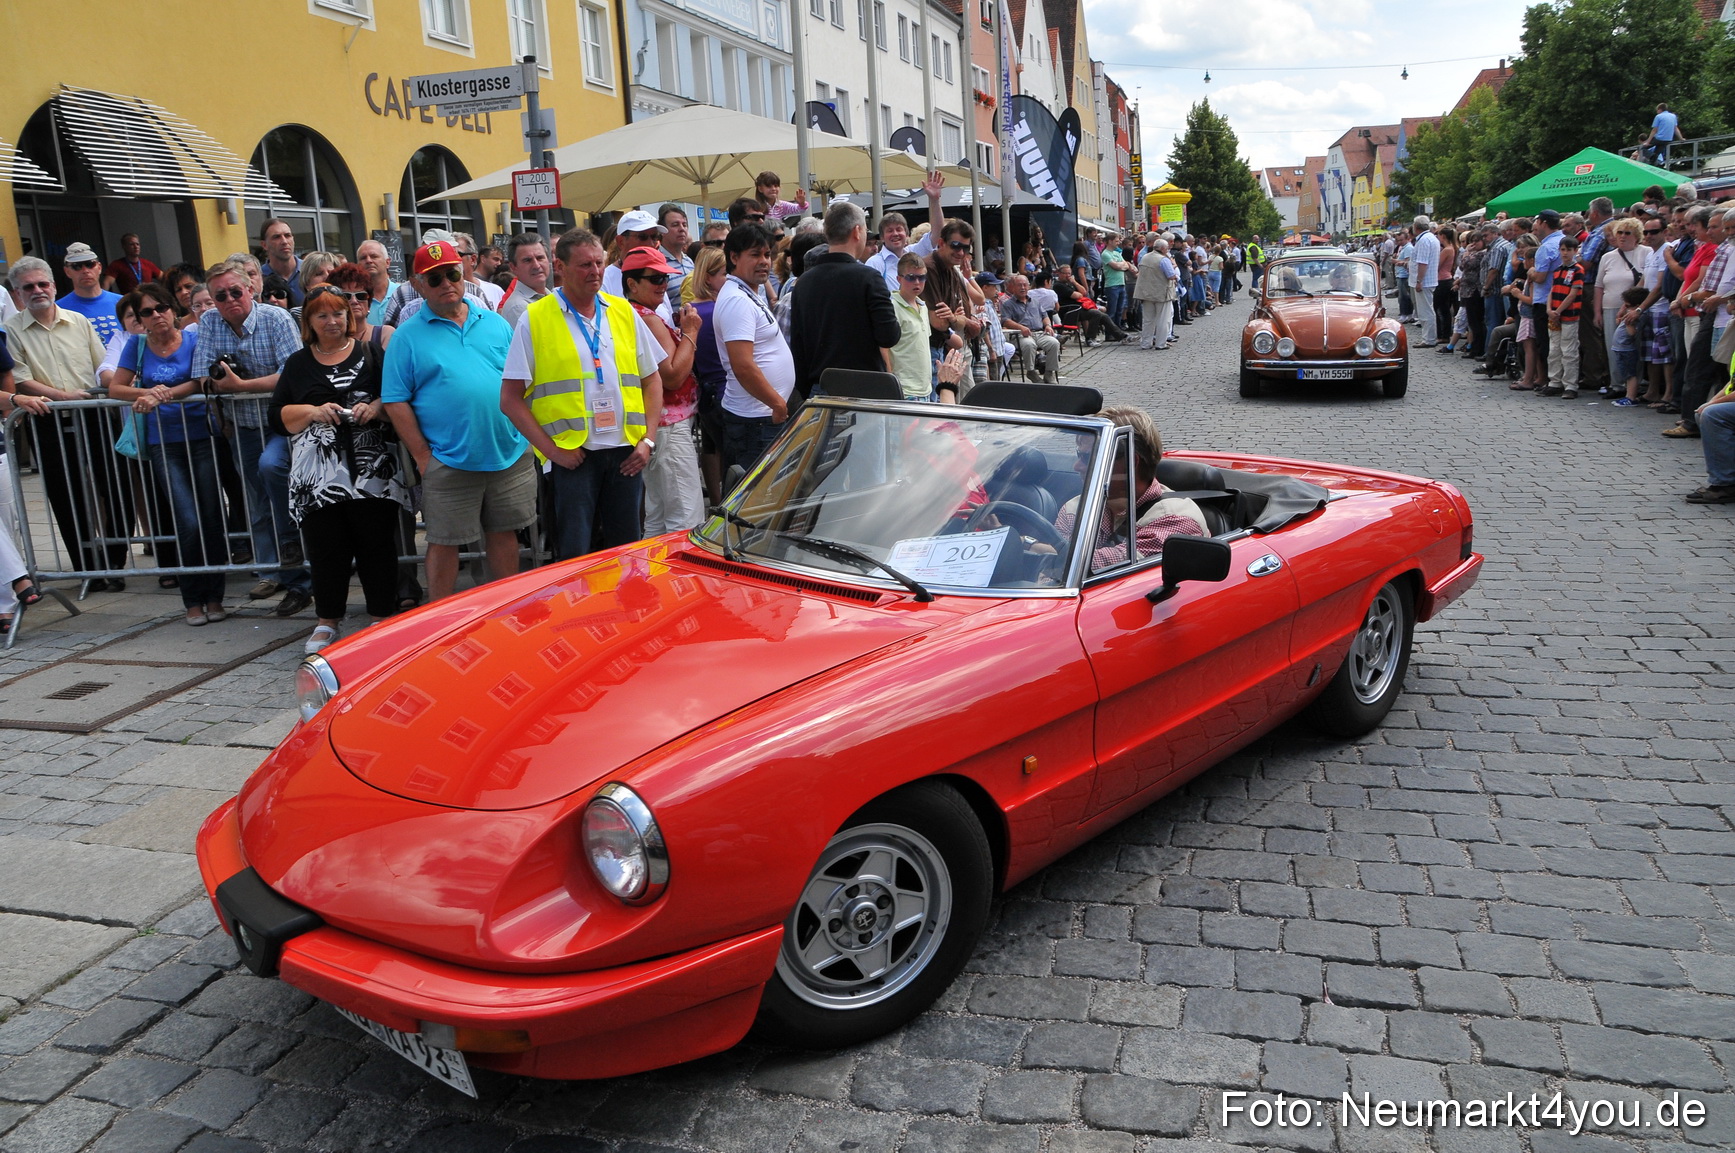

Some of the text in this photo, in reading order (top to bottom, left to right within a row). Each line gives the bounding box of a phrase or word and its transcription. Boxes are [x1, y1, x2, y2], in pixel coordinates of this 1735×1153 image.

[417, 76, 511, 98] Klostergasse
[517, 173, 547, 184] H 200
[1131, 154, 1142, 208] HOTEL
[1542, 177, 1618, 189] Lammsbräu
[1555, 174, 1610, 183] Neumarkter
[943, 543, 992, 564] 202
